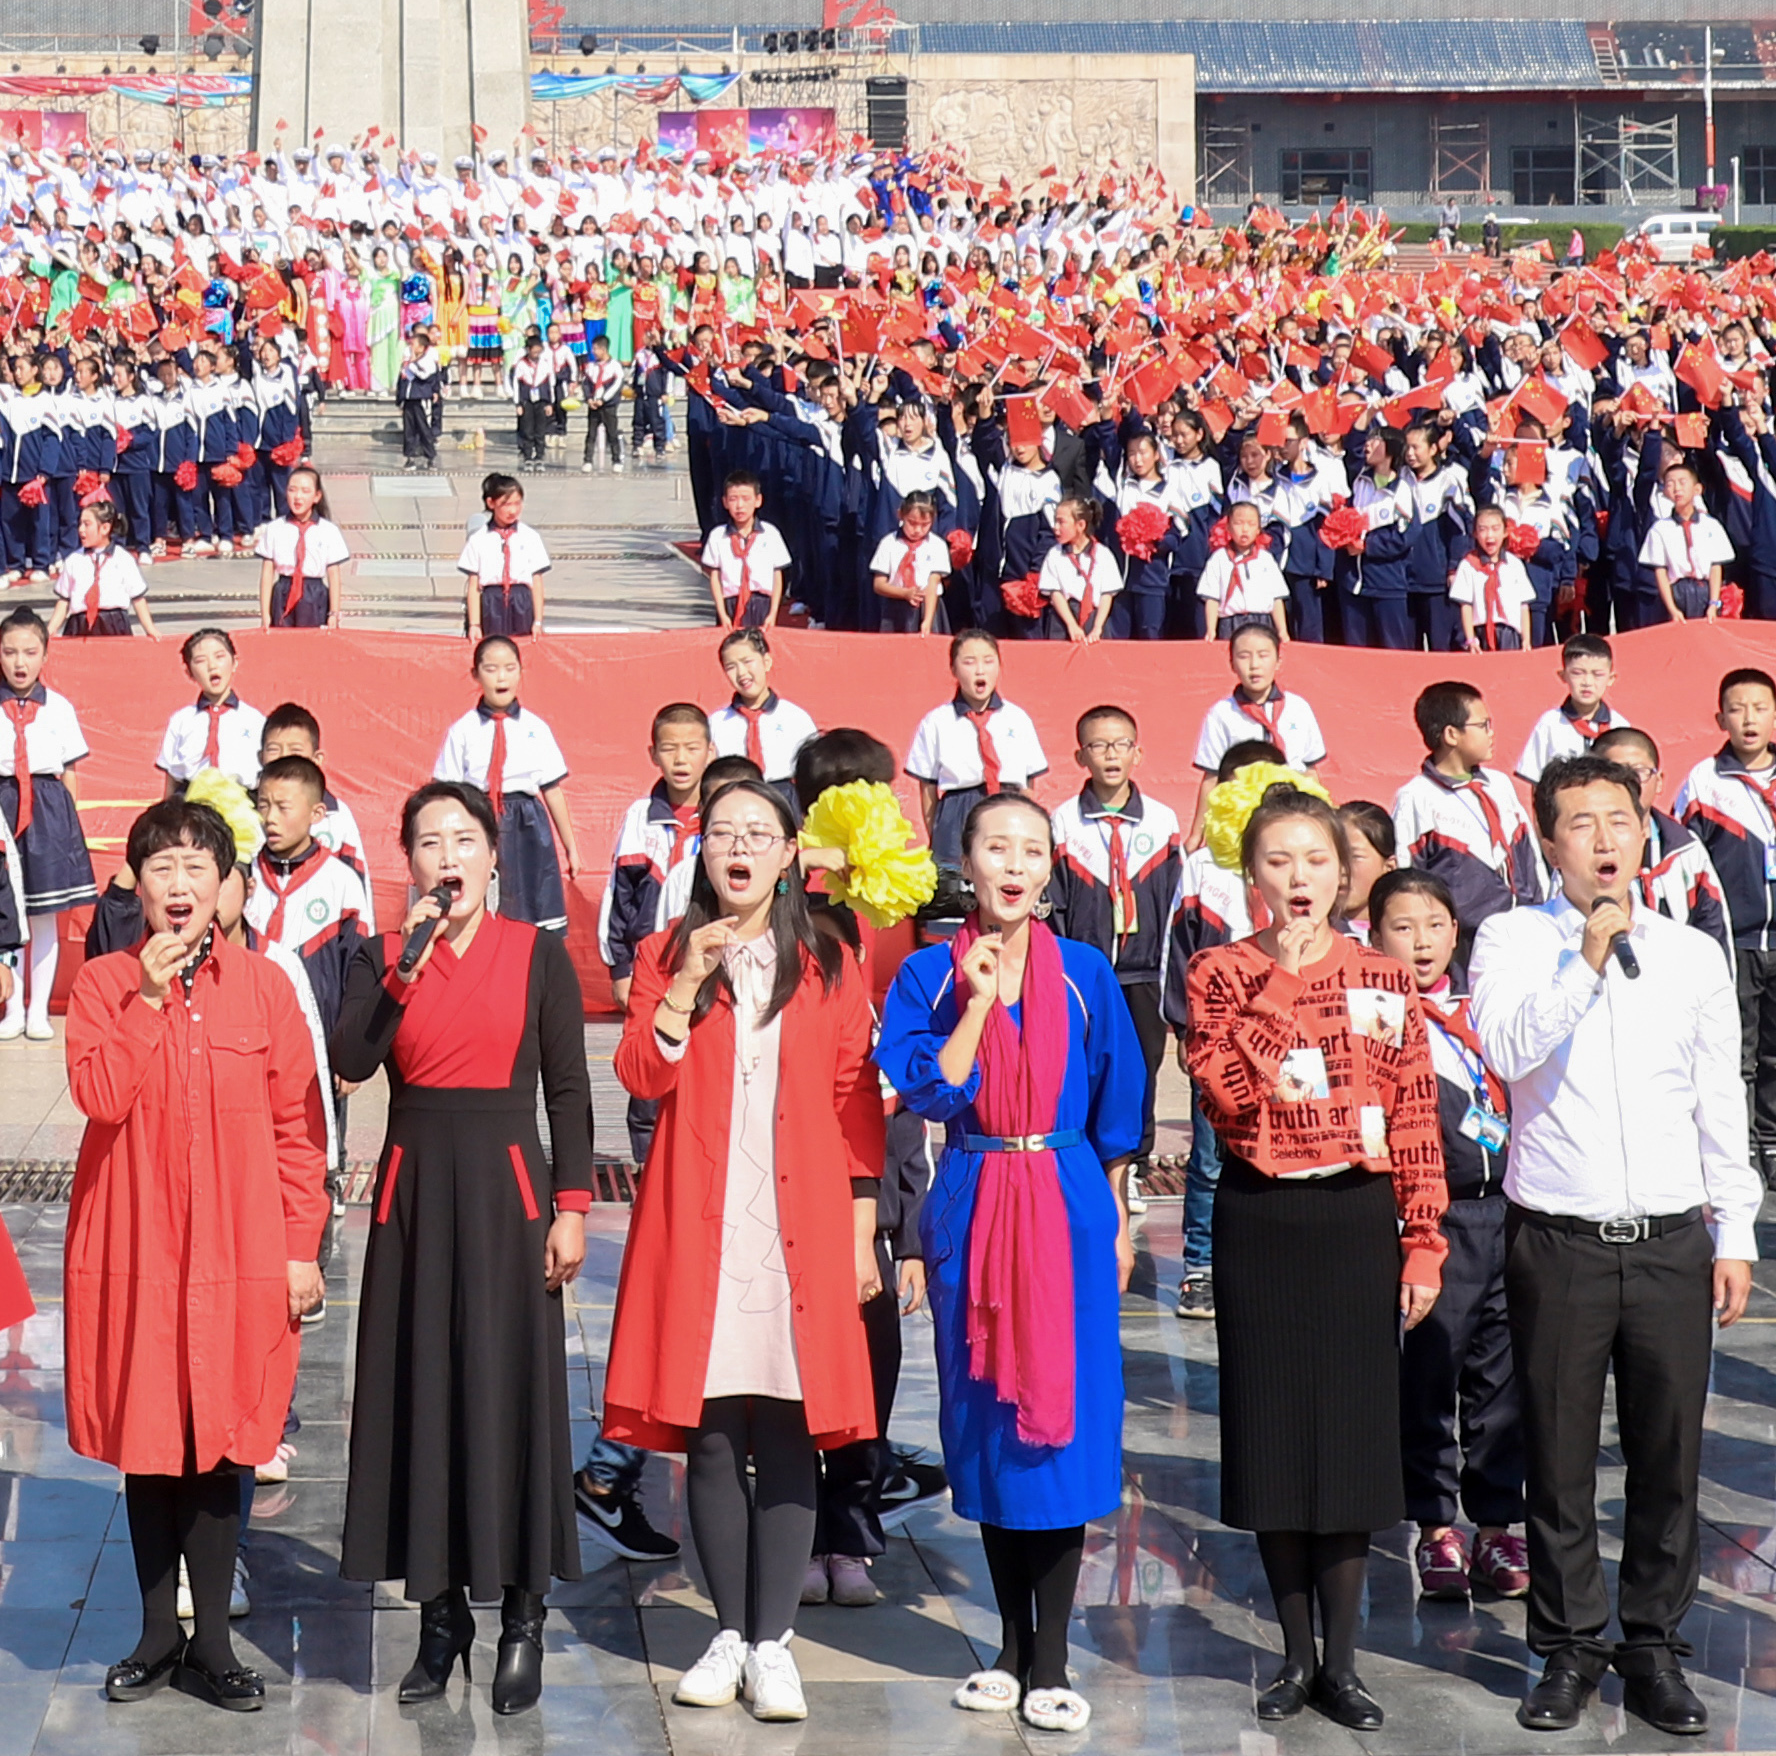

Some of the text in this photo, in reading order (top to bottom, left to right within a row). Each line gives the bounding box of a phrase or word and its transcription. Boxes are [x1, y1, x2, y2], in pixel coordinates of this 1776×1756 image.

[1310, 967, 1347, 992] art
[1318, 1026, 1352, 1056] art
[1268, 1102, 1321, 1130] truth
[1269, 1147, 1322, 1161] Celebrity
[1389, 1140, 1440, 1167] truth
